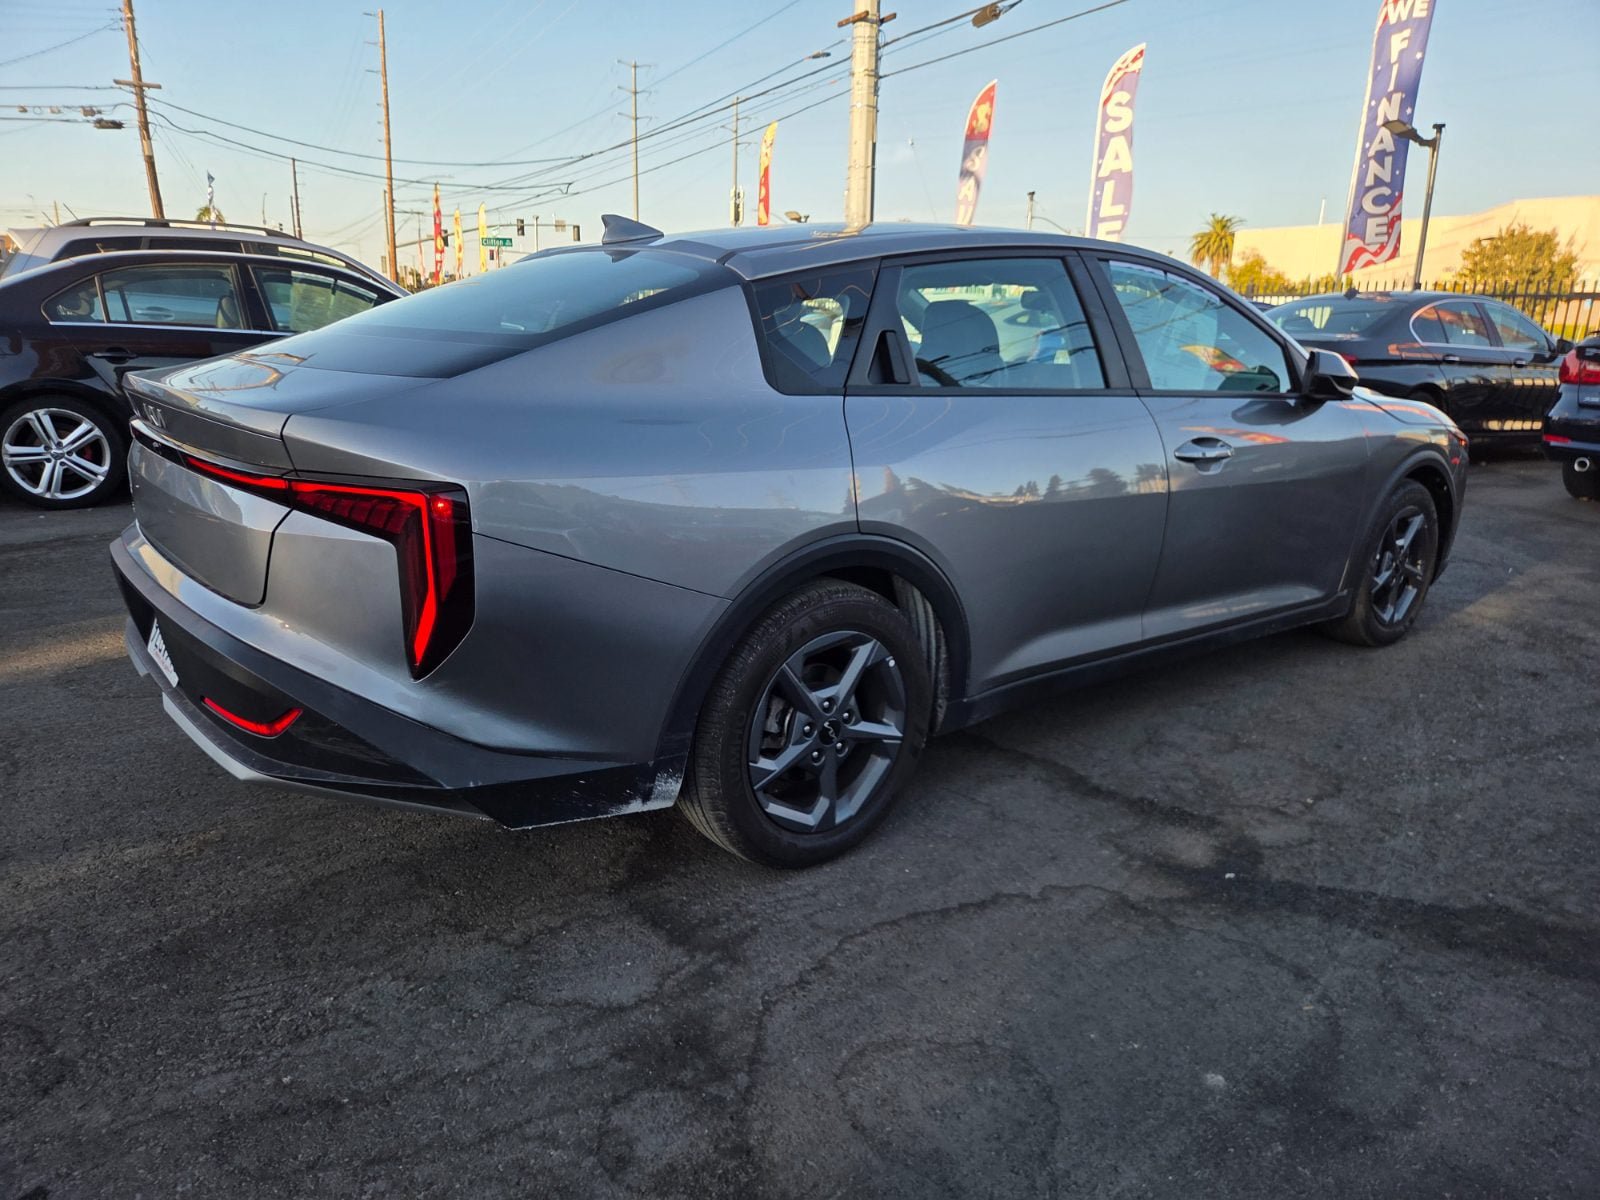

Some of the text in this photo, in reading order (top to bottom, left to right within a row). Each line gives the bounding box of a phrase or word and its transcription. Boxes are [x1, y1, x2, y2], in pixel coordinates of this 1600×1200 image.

[1387, 0, 1429, 25] WE
[1096, 90, 1134, 242] SALE
[1361, 28, 1411, 245] FINANCE
[482, 238, 504, 246] Clifton
